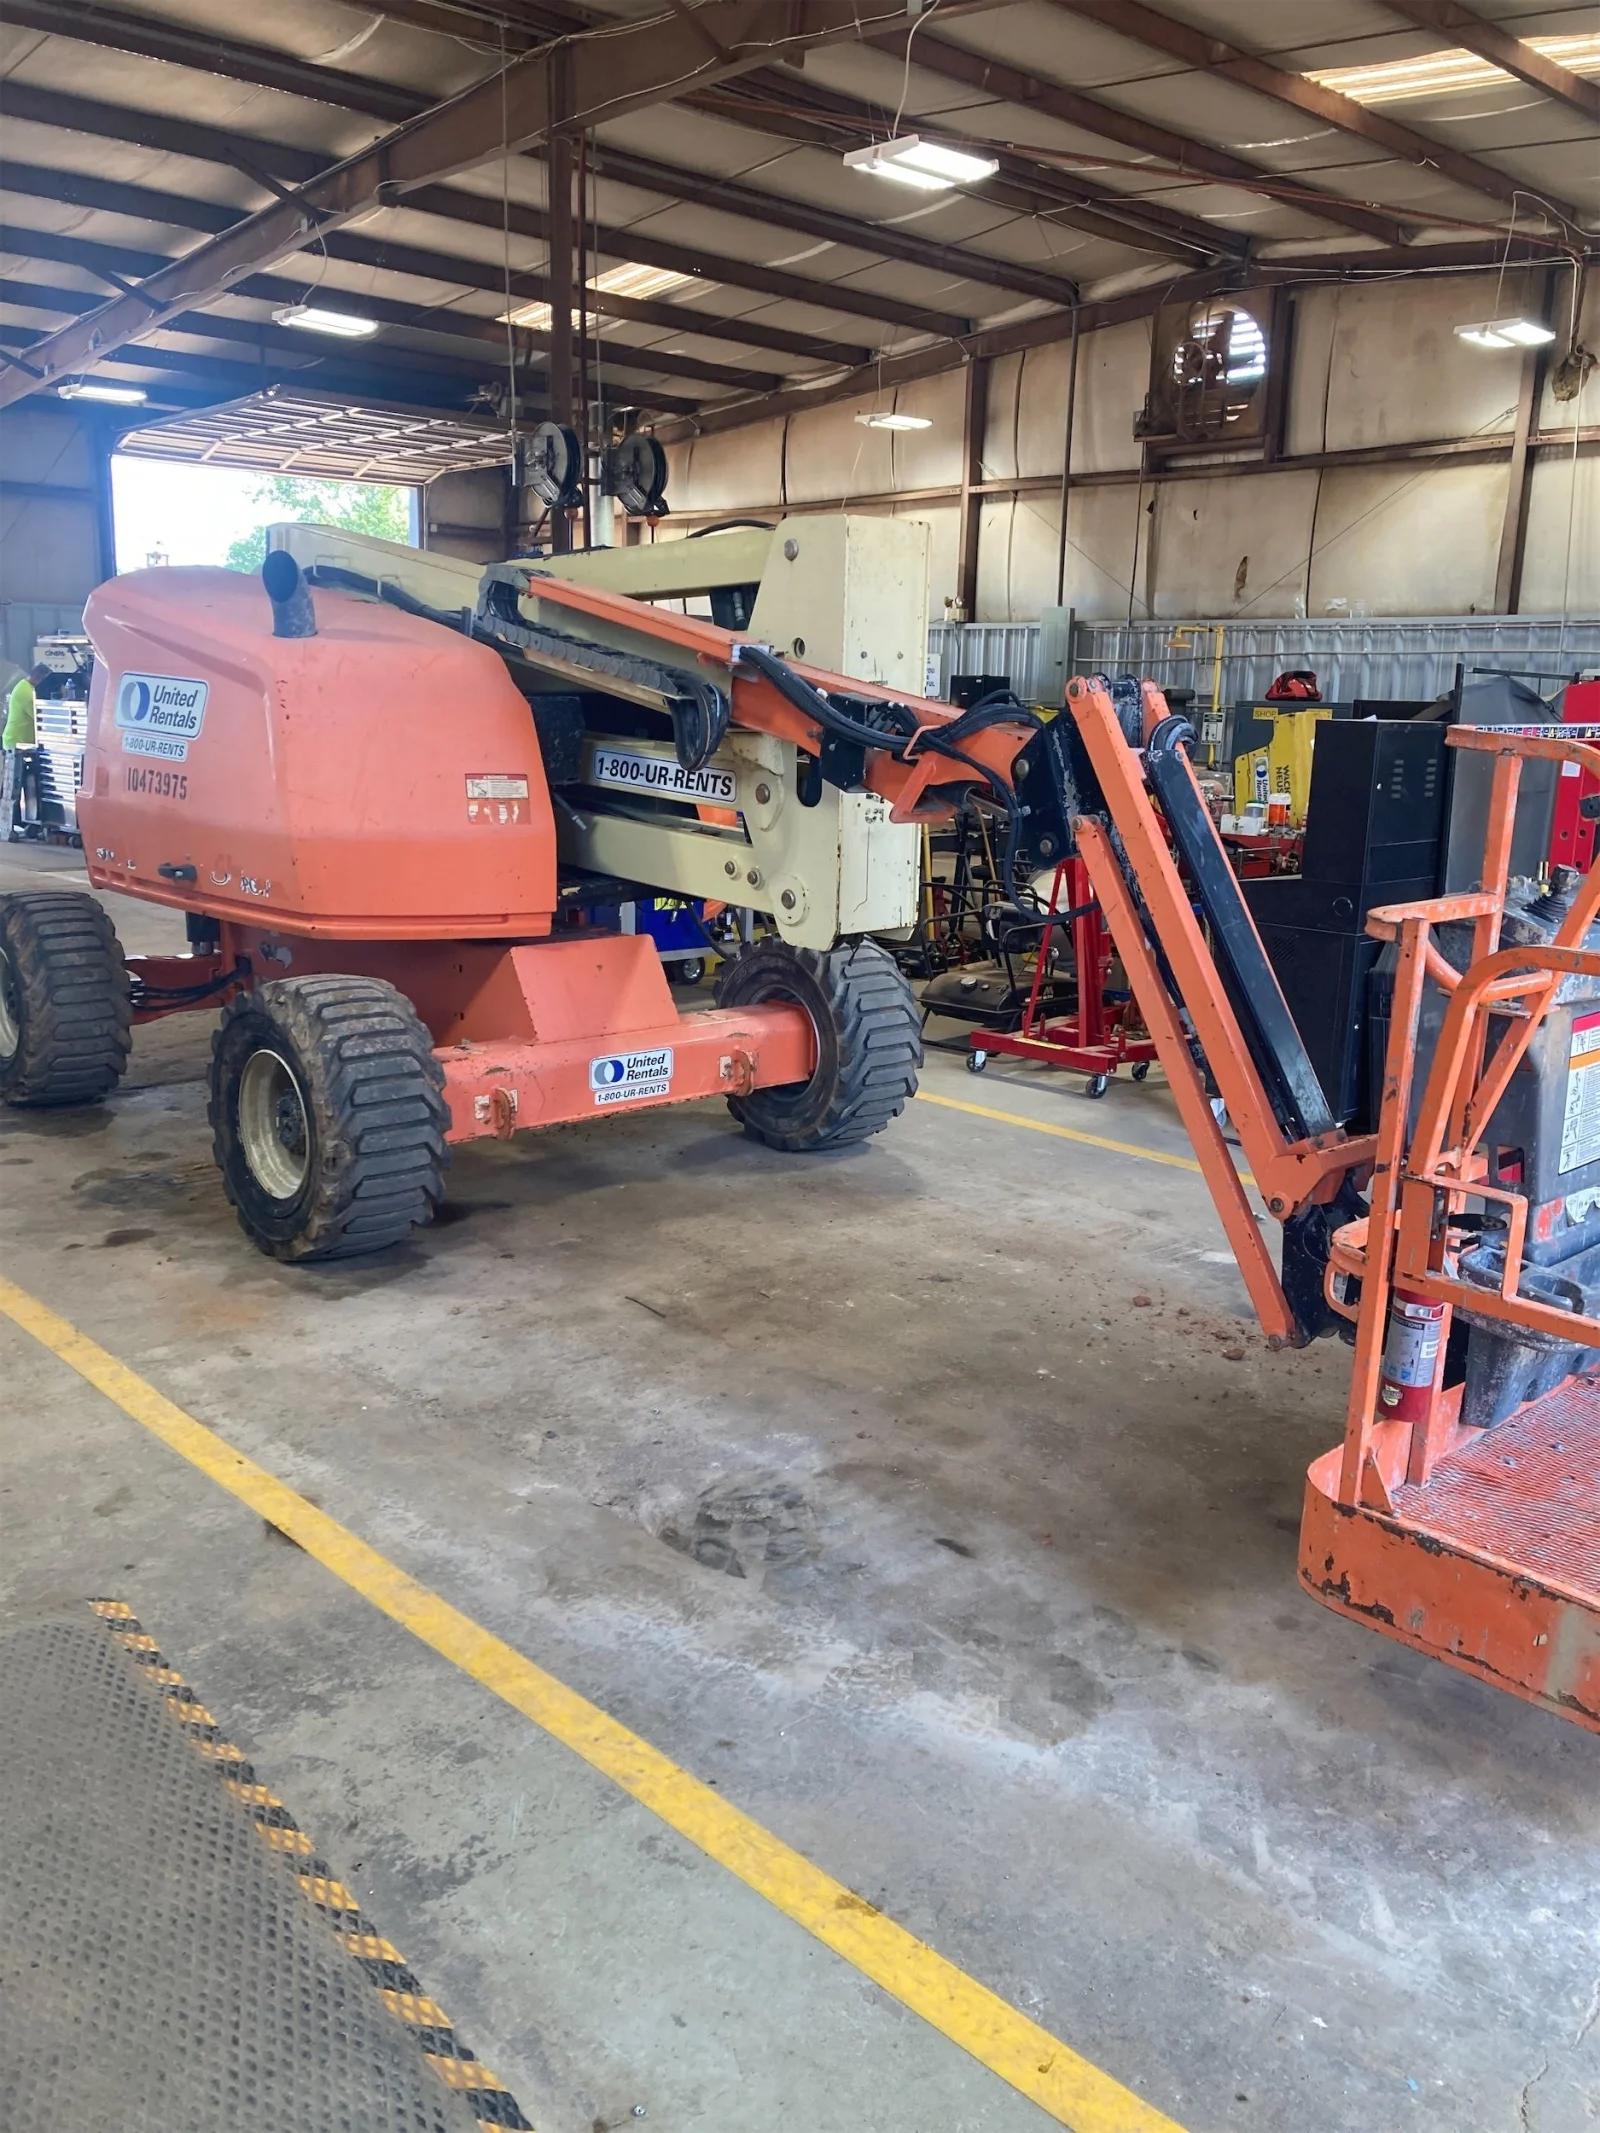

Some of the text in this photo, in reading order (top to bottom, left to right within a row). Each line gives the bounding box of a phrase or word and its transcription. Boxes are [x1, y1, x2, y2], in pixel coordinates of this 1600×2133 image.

[153, 684, 198, 707] United
[149, 706, 197, 729] Rentals
[125, 737, 185, 757] 1-800-UR-RENTS
[127, 767, 188, 800] 10473975
[597, 757, 733, 796] 1-800-UR-RENTS
[627, 1053, 666, 1069] United
[626, 1066, 669, 1081] Rentals
[598, 1083, 667, 1102] 1-800-UR-RENTS
